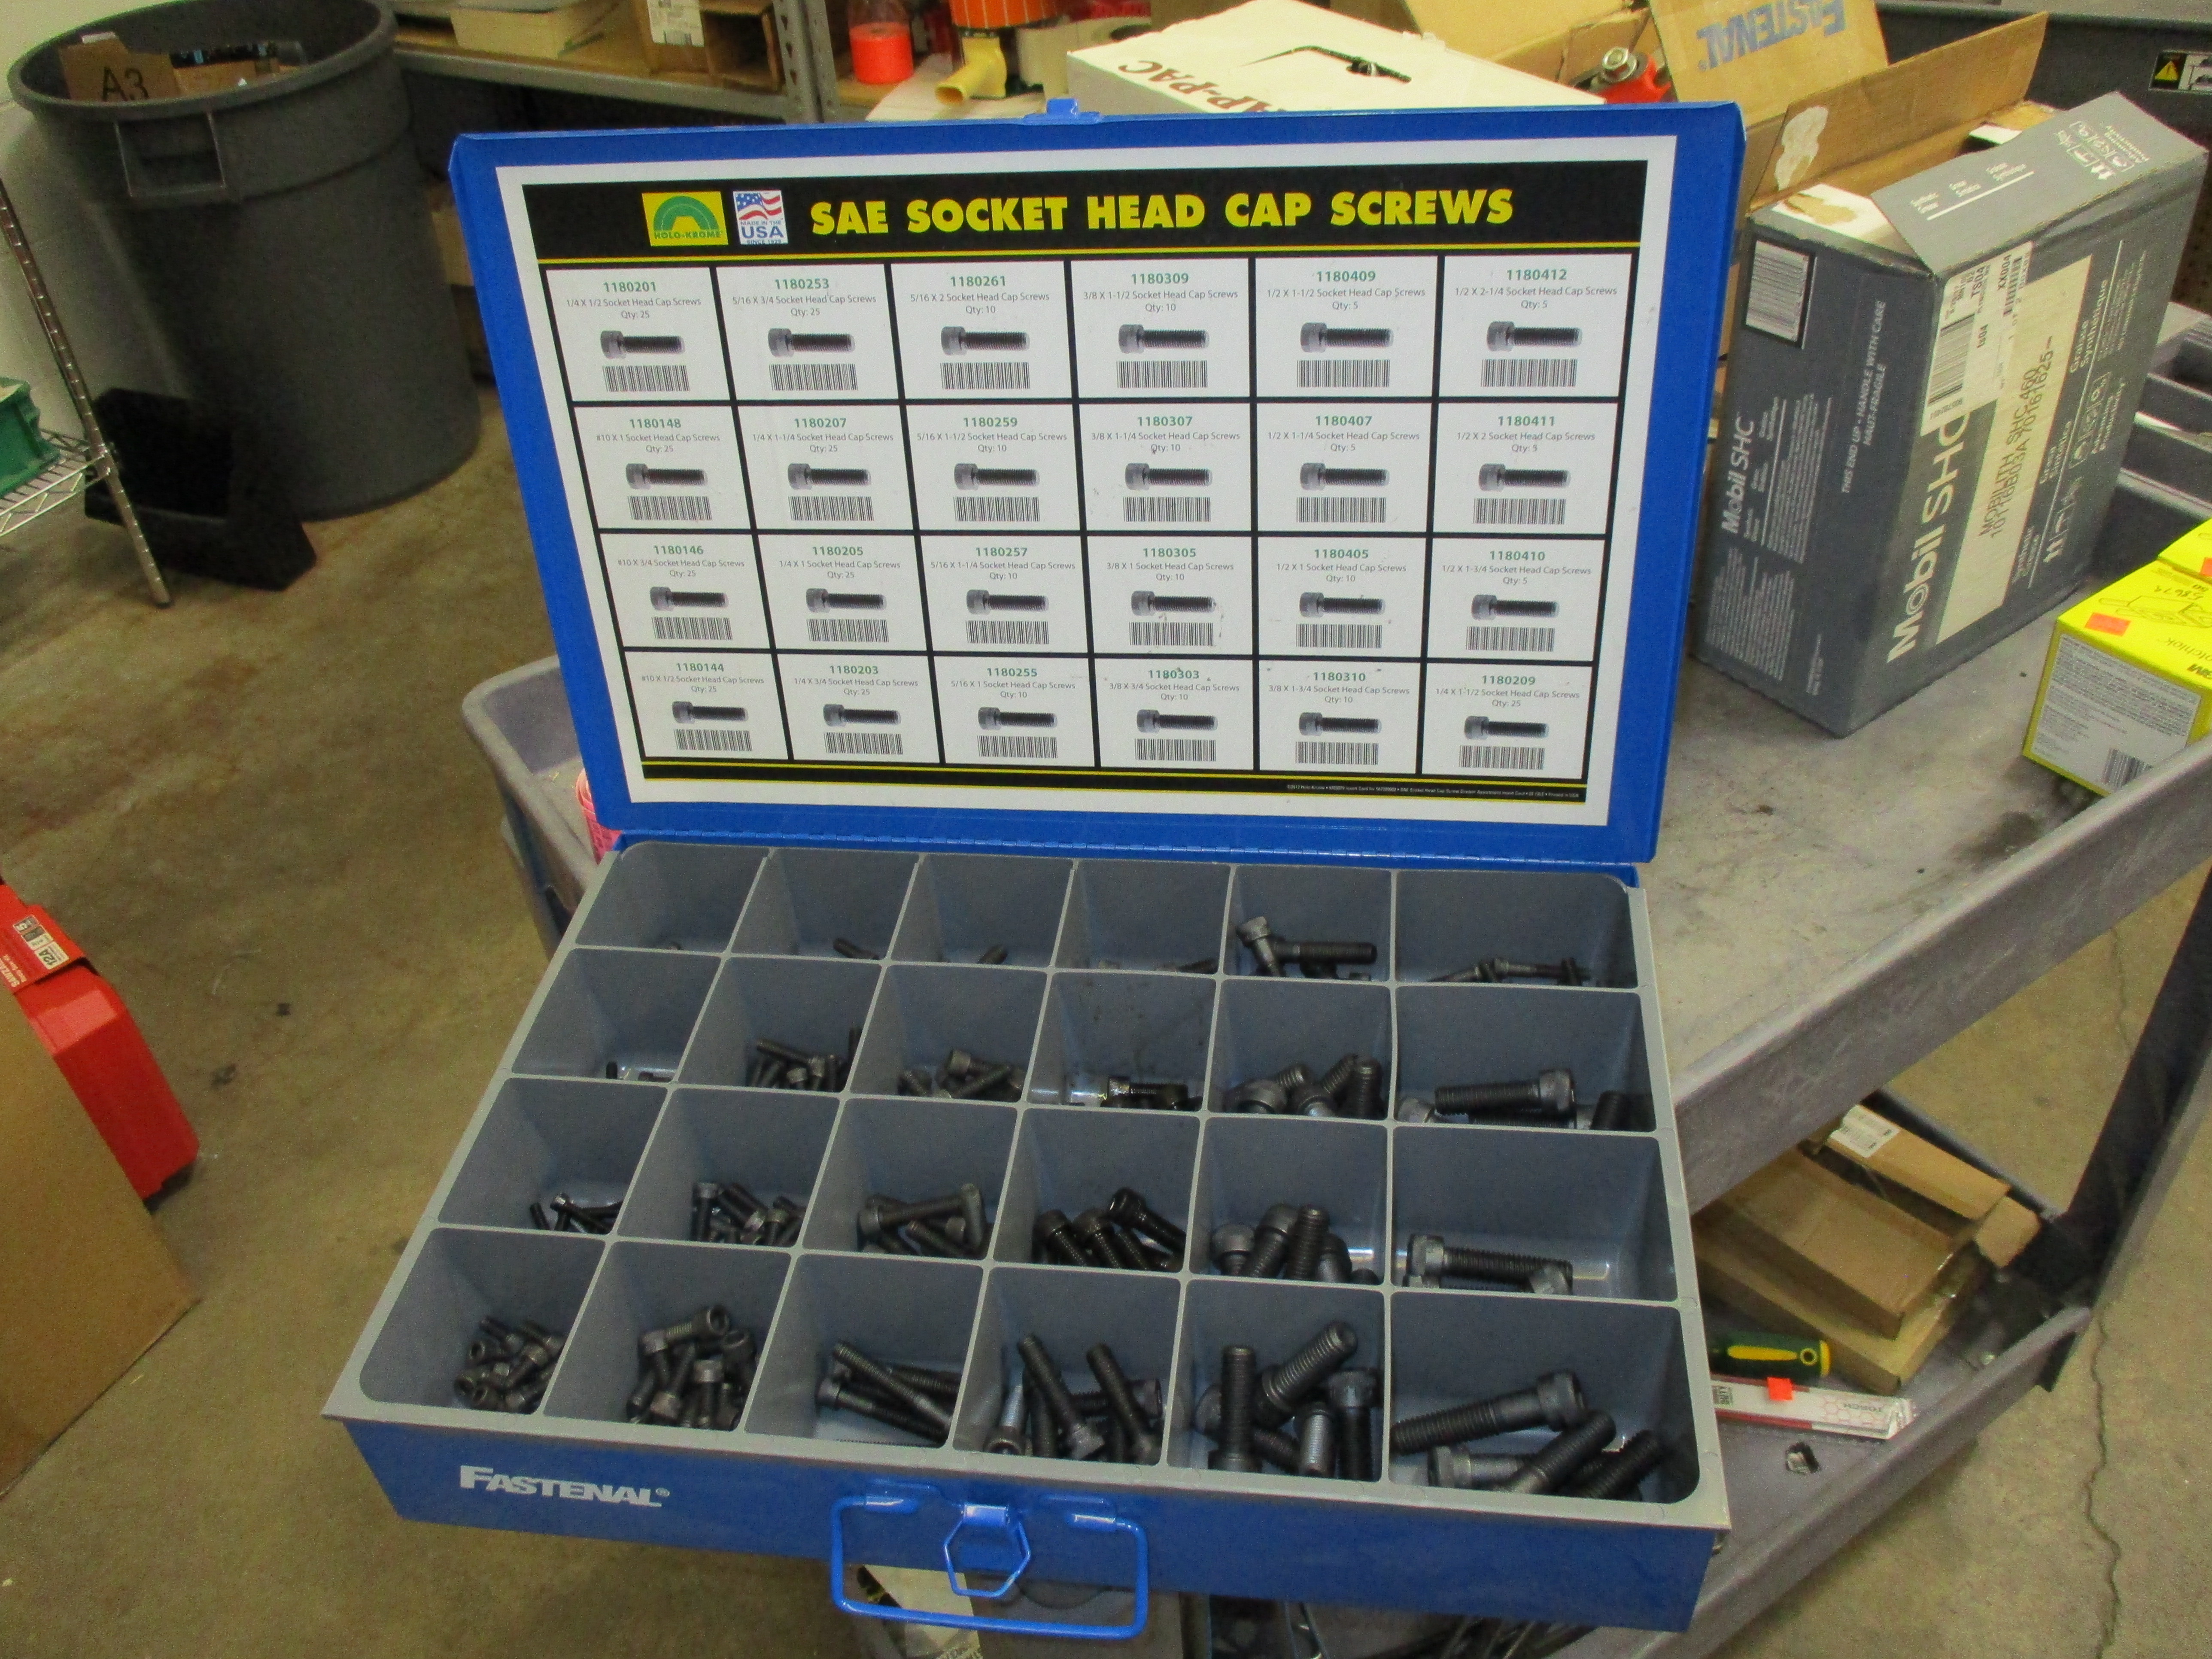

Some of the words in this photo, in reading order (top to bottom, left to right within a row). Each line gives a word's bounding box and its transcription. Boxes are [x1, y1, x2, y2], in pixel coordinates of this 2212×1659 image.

[811, 201, 888, 234] SAE
[907, 197, 1067, 232] SOCKET
[1087, 195, 1205, 229] HEAD
[1225, 193, 1311, 227] CAP
[1331, 189, 1513, 225] SCREWS
[654, 231, 721, 239] HOLO-KROME
[741, 225, 784, 239] USA
[1130, 272, 1190, 286] 1180309
[1316, 270, 1376, 283] 1180409
[1507, 268, 1568, 281] 1180412
[602, 280, 656, 293] 1180201
[774, 277, 830, 290] 1180253
[950, 275, 1006, 288] 1180261
[1083, 291, 1098, 300] 3/8
[1099, 291, 1106, 300] X
[1108, 291, 1130, 300] 1-1/2
[1132, 290, 1161, 300] Socket
[1163, 289, 1187, 300] Head
[1188, 289, 1206, 301] Cap
[1207, 289, 1238, 299] Screws
[566, 299, 580, 307] 1/4
[580, 299, 587, 307] X
[588, 298, 602, 307] 1/2
[602, 298, 630, 307] Socket
[632, 298, 654, 307] Head
[655, 298, 672, 307] Cap
[672, 297, 702, 306] Screws
[1145, 303, 1164, 313] Qty:
[1166, 303, 1177, 312] 10
[620, 310, 638, 320] Qty:
[640, 310, 650, 319] 25
[1856, 369, 1873, 418] HANDLE
[629, 418, 682, 429] 1180148
[793, 417, 847, 428] 1180207
[963, 416, 1018, 428] 1180259
[1137, 415, 1193, 427] 1180307
[1315, 415, 1373, 427] 1180407
[1498, 415, 1555, 427] 1180411
[917, 433, 936, 441] 5/16
[937, 432, 943, 441] X
[945, 432, 966, 441] 1-1/2
[967, 432, 995, 441] Socket
[997, 432, 1019, 441] Head
[1020, 432, 1037, 442] Cap
[1038, 432, 1068, 441] Screws
[1457, 432, 1471, 441] 1/2
[1472, 432, 1479, 440] X
[1480, 432, 1486, 441] 2
[1489, 431, 1518, 441] Socket
[1519, 432, 1544, 441] Head
[1545, 432, 1563, 442] Cap
[1565, 431, 1595, 441] Screws
[1730, 416, 1755, 470] SHC
[977, 444, 995, 454] Qty:
[997, 444, 1007, 452] 10
[1511, 444, 1531, 454] Qty:
[1532, 444, 1538, 452] 5
[1979, 453, 2015, 537] MOBILITH
[2005, 406, 2028, 446] SHC
[2020, 368, 2038, 400] 460
[1721, 471, 1747, 534] Mobil
[1887, 524, 1946, 663] Mobil
[1921, 411, 1972, 524] SHC
[653, 544, 705, 556] 1180146
[811, 545, 864, 556] 1180205
[975, 547, 1028, 557] 1180257
[1142, 547, 1197, 558] 1180305
[1314, 548, 1369, 559] 1180405
[1489, 550, 1546, 562] 1180410
[806, 560, 833, 568] Socket
[834, 560, 856, 568] Head
[856, 560, 872, 570] Cap
[873, 560, 901, 568] Screws
[1277, 563, 1290, 571] 1/2
[1306, 563, 1334, 571] Socket
[1336, 563, 1358, 572] Head
[1359, 564, 1376, 573] Cap
[1377, 564, 1407, 572] Screws
[826, 571, 843, 580] Qty:
[1325, 574, 1343, 583] Qty:
[675, 662, 725, 672] 1180144
[829, 664, 879, 675] 1180203
[986, 667, 1038, 678] 1180255
[1148, 670, 1200, 680] 1180303
[1313, 671, 1367, 682] 1180310
[1481, 675, 1536, 686] 1180209
[1032, 681, 1048, 690] Cap
[1195, 684, 1211, 692] Cap
[1212, 684, 1240, 692] Screws
[1000, 690, 1016, 699] Qty:
[1160, 693, 1177, 702] Qty:
[460, 1465, 662, 1507] FASTENAL
